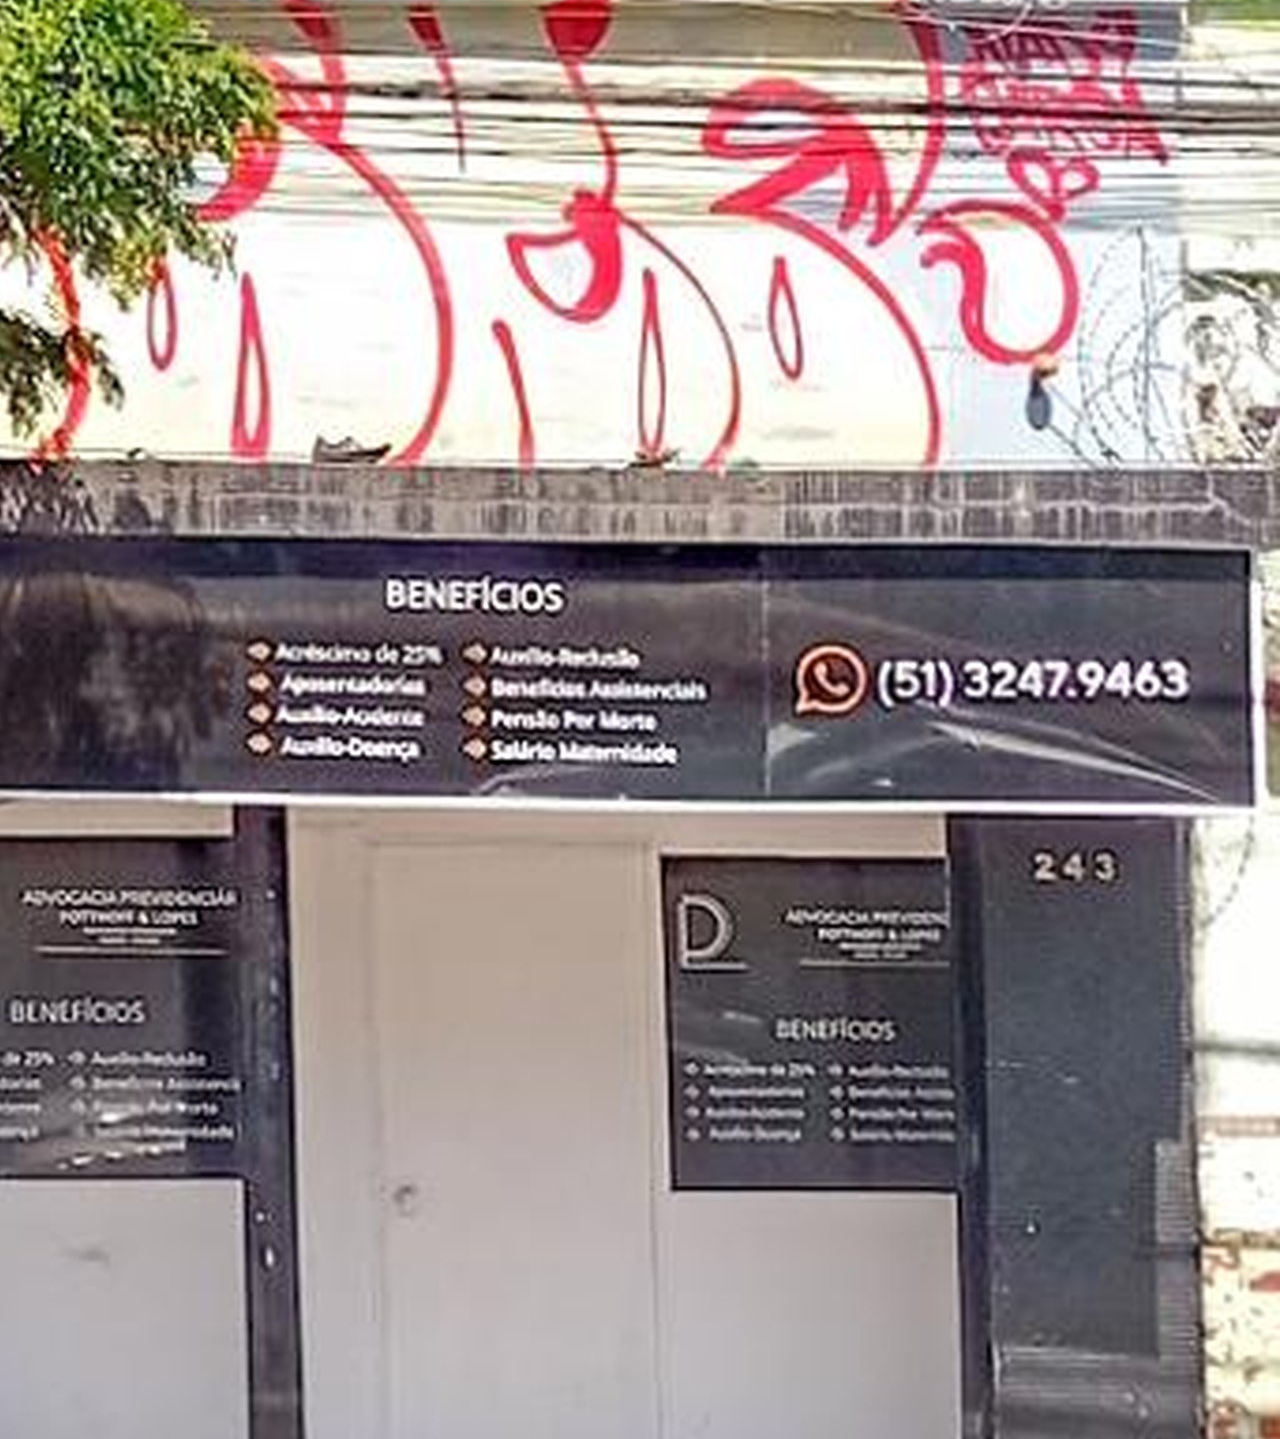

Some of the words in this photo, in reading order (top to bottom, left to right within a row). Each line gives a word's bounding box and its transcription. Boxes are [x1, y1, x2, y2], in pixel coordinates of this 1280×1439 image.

[386, 576, 564, 612] BENEFÍCIOS
[878, 660, 957, 711] (51)
[963, 659, 1190, 698] 3247.9463
[10, 997, 146, 1023] BENEFÍCIOS
